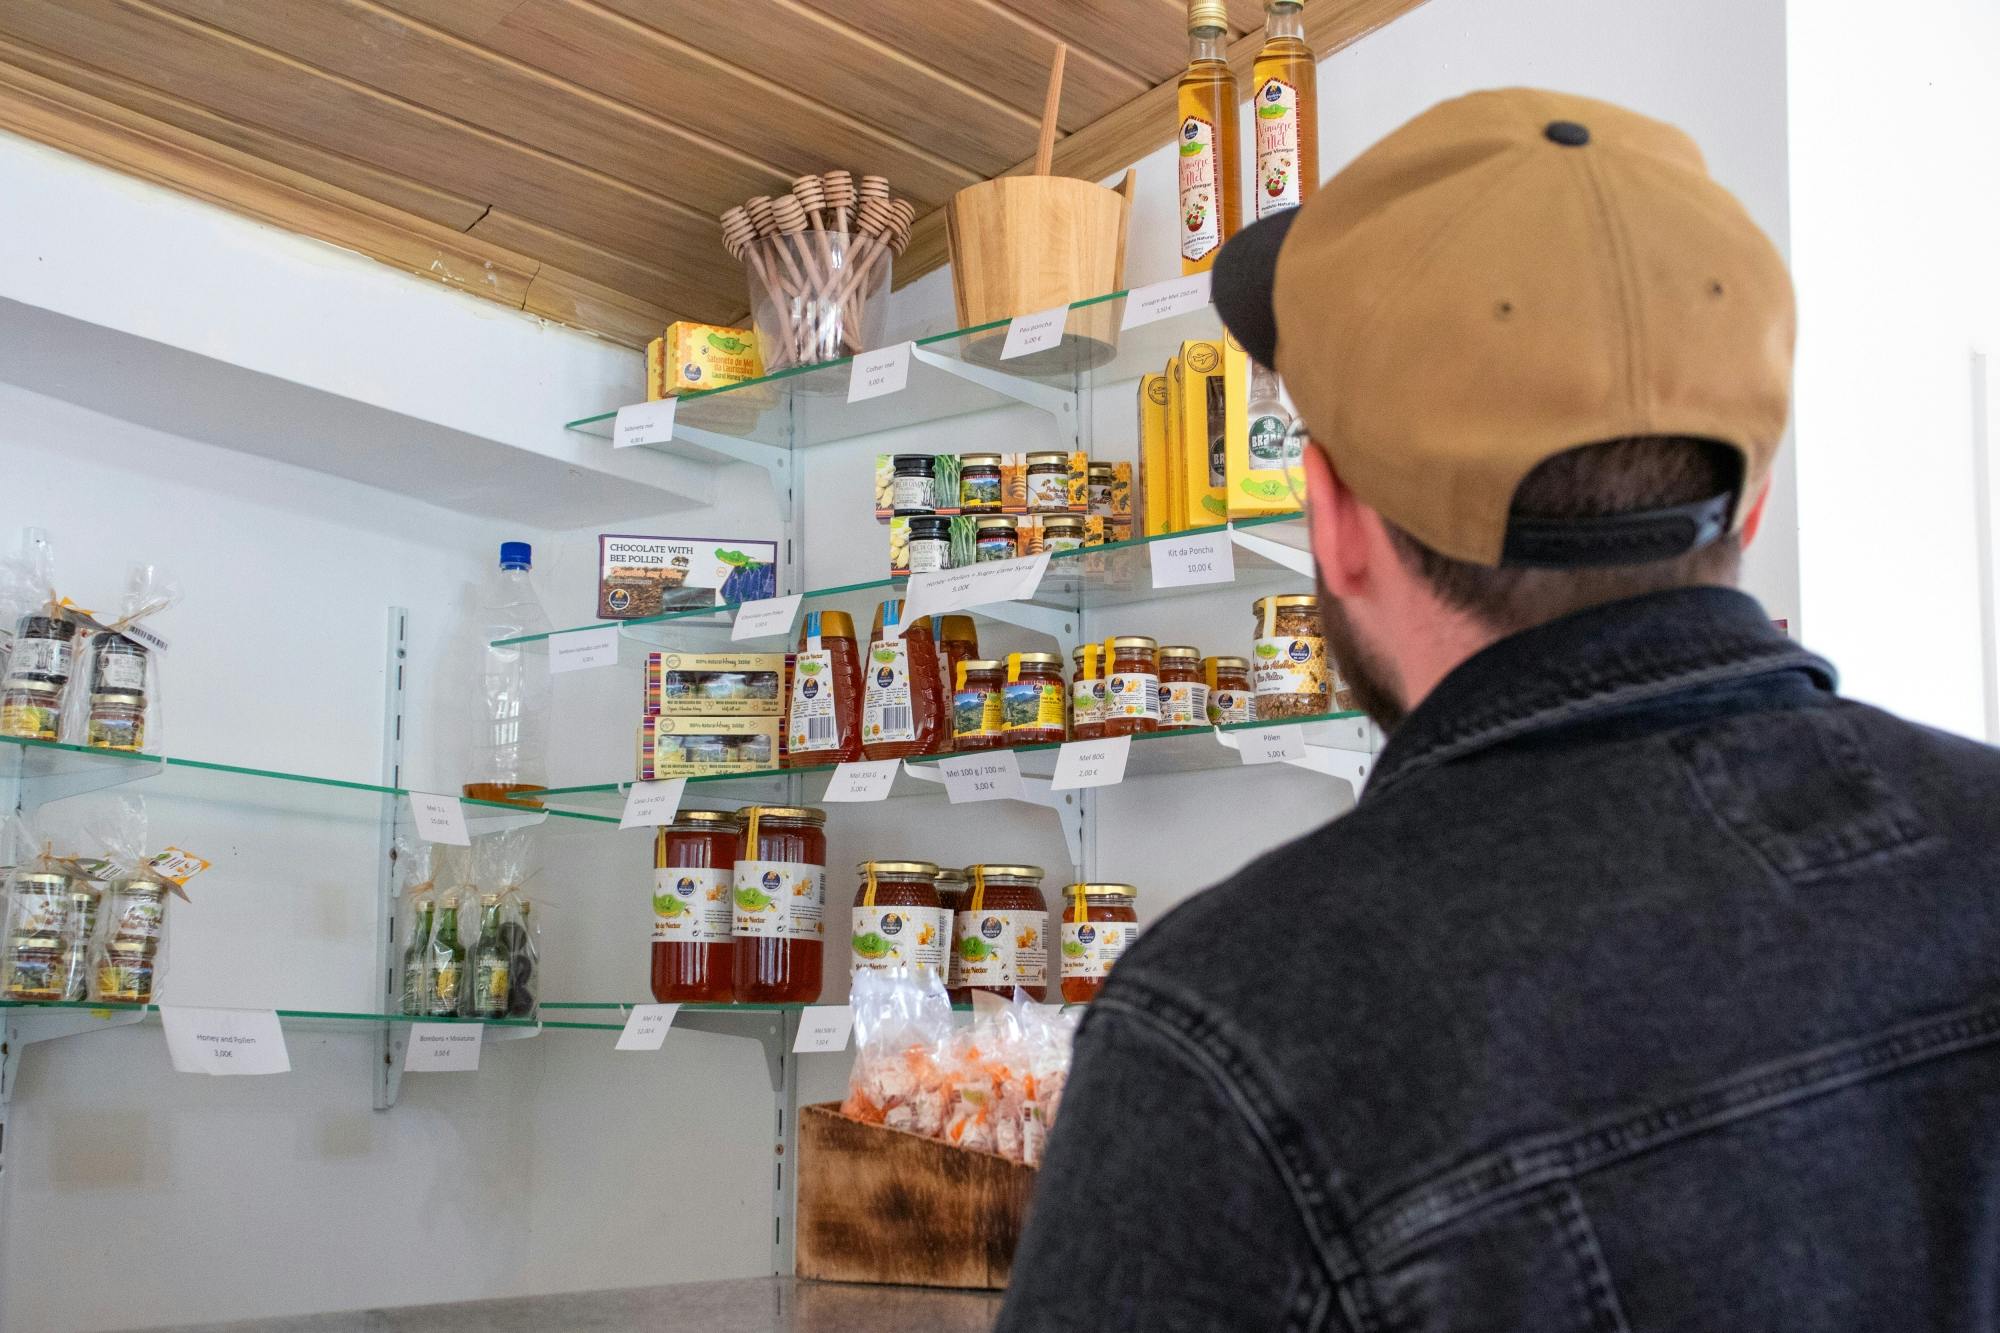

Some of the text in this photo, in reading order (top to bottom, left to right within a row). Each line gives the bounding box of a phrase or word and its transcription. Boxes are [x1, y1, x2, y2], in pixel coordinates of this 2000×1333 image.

[1266, 133, 1286, 150] Mel
[1186, 168, 1203, 186] Mel
[1192, 182, 1212, 190] Vinegar
[609, 543, 694, 555] CHOCOLATE WITH
[1168, 545, 1214, 557] Kit da Poncha
[609, 554, 663, 564] BEE POLLEN
[1188, 564, 1206, 573] 10,00
[1079, 753, 1091, 761] Mel
[946, 769, 960, 778] Mel
[961, 768, 973, 777] 100
[983, 766, 997, 774] 100
[196, 1034, 219, 1043] Honey
[233, 1036, 257, 1044] Pollen
